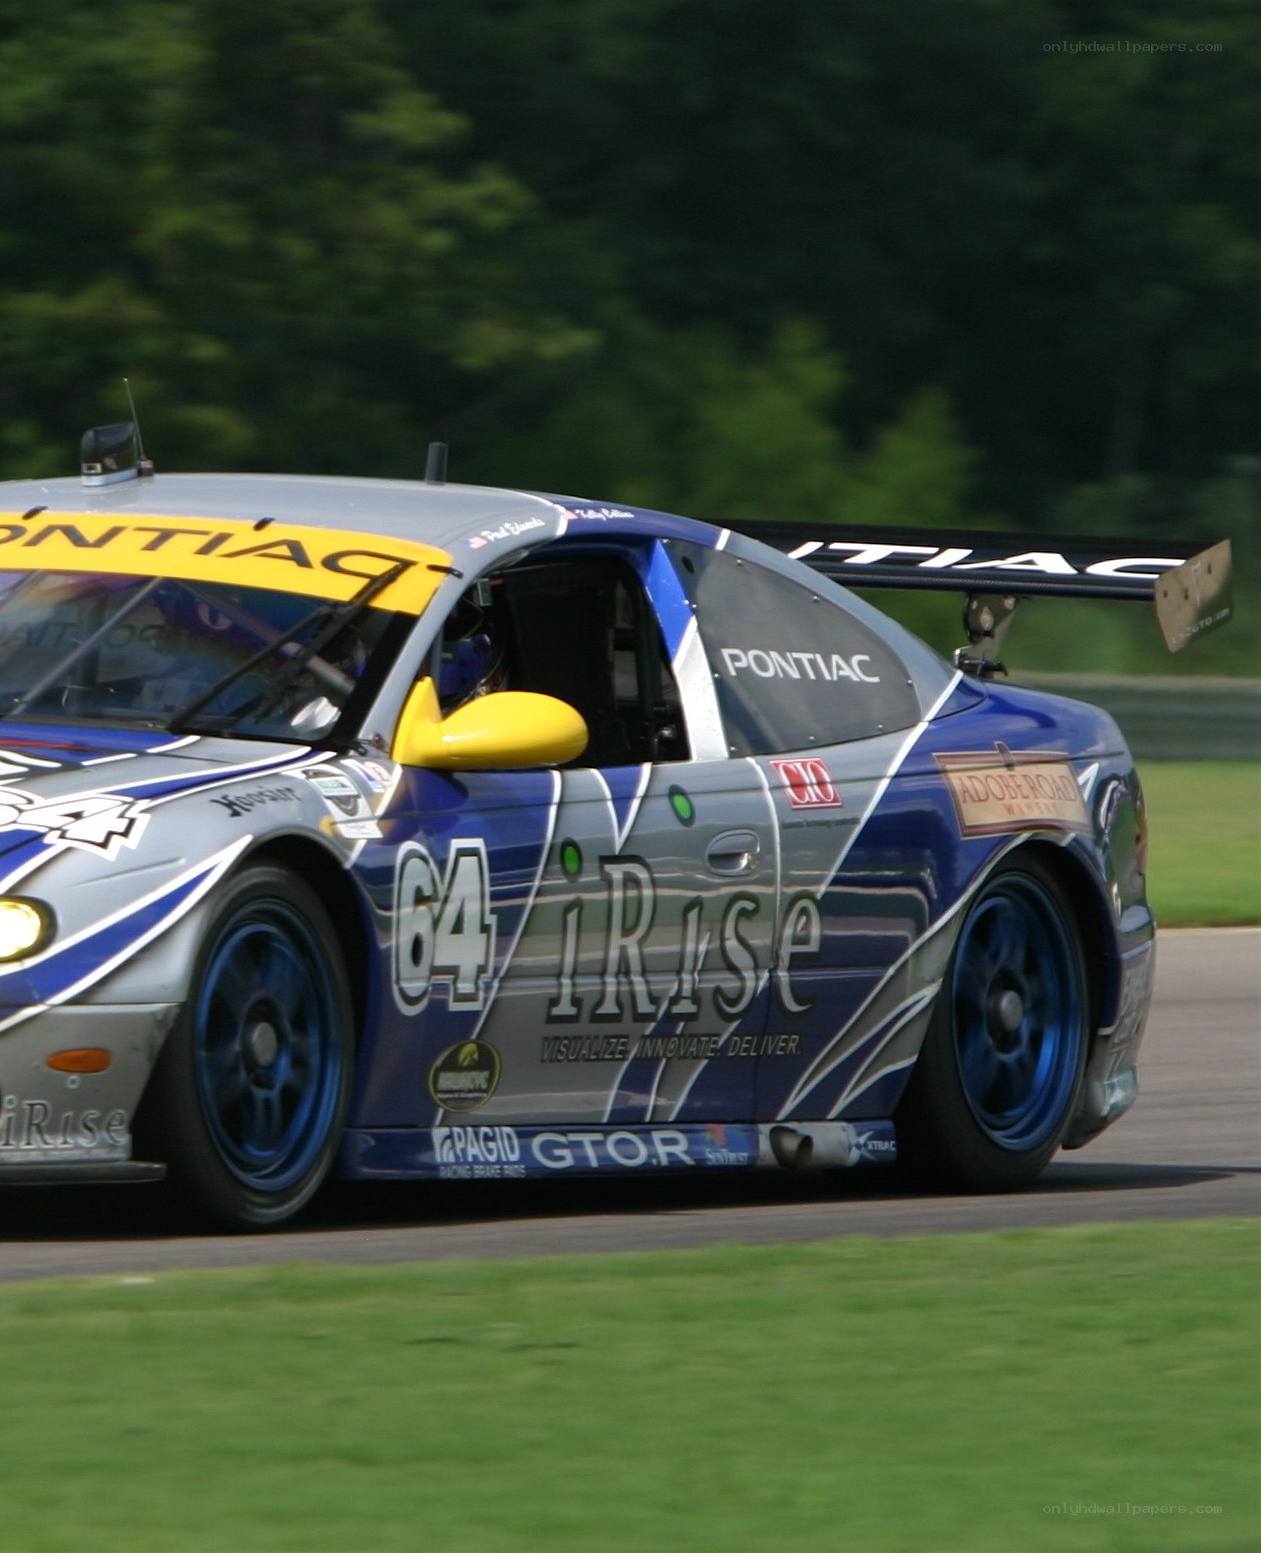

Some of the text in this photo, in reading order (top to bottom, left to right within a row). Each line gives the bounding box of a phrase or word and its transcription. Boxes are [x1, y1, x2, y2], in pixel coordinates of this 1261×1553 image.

[721, 647, 881, 684] PONTIAC
[959, 774, 1078, 804] ADOBE ROAD
[392, 837, 498, 1016] 64
[727, 1034, 802, 1058] DELIVER.
[454, 1126, 521, 1163] PAGID
